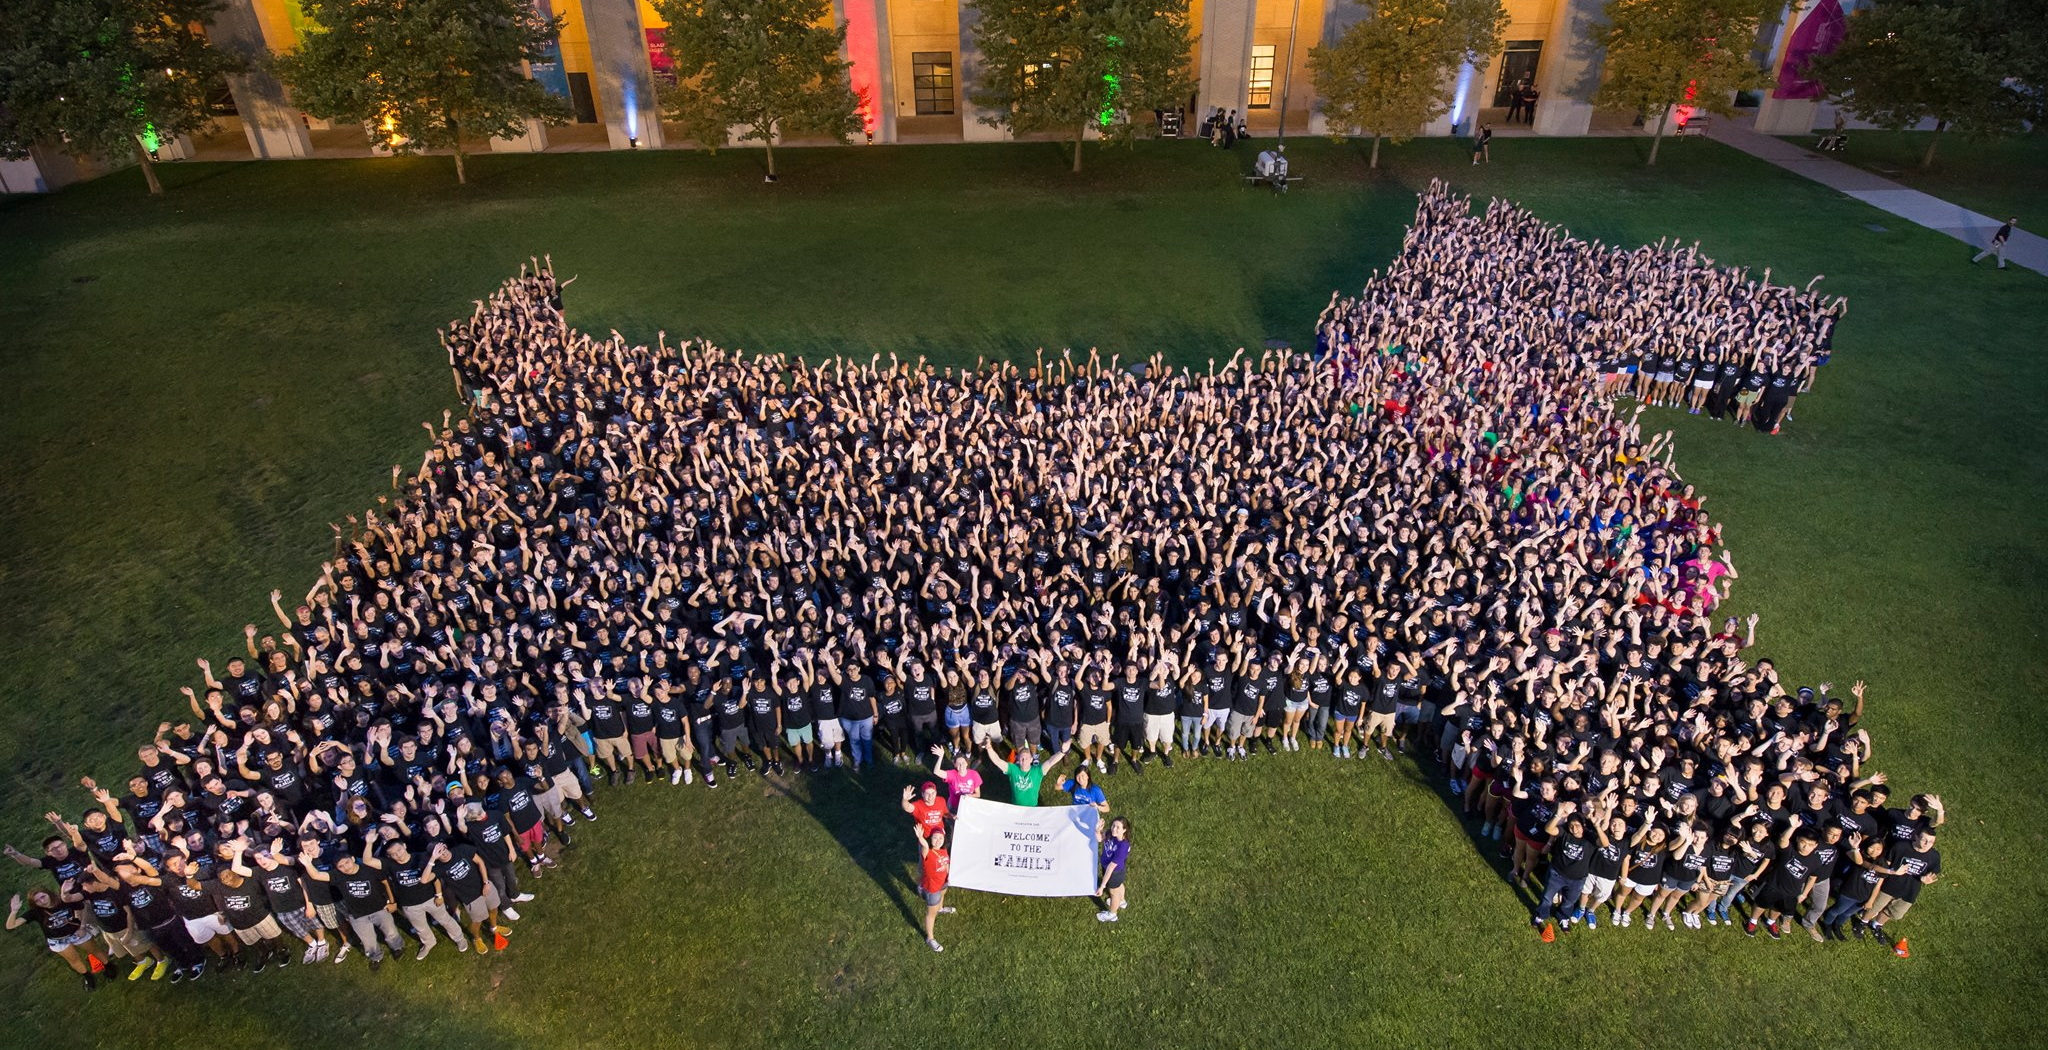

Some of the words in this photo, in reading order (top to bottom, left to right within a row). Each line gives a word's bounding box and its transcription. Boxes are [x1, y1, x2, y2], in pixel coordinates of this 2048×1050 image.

[1003, 831, 1050, 842] WELCOME
[1010, 843, 1021, 852] TO
[1023, 844, 1042, 854] THE
[994, 854, 1055, 870] FAMILY
